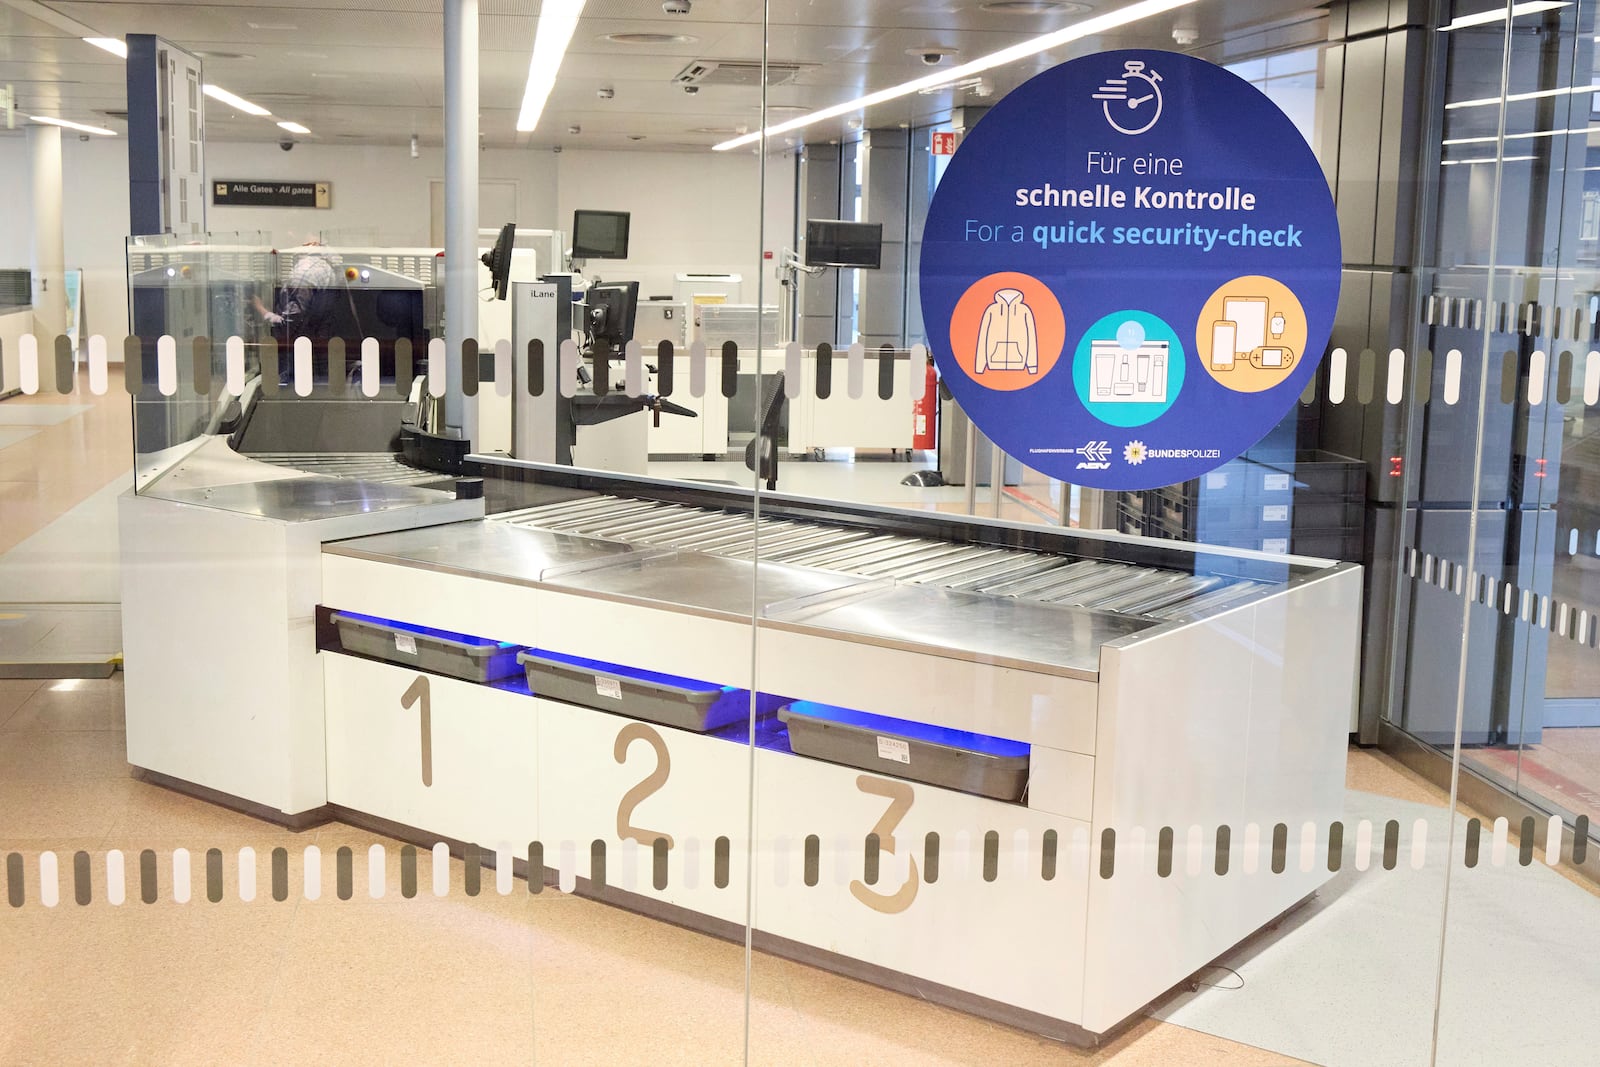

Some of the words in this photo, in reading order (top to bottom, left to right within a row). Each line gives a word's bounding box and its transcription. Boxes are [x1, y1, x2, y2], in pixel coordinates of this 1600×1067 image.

[1087, 151, 1127, 174] Für
[1133, 153, 1184, 176] eine
[233, 184, 249, 193] Alle
[250, 185, 273, 194] Gates
[279, 185, 291, 194] All
[291, 186, 313, 196] gates
[1015, 184, 1127, 209] schnelle
[1134, 187, 1256, 211] Kontrolle
[965, 220, 1003, 242] For
[1010, 226, 1025, 243] a
[1032, 221, 1106, 250] quick
[1112, 223, 1303, 252] security-check
[530, 289, 555, 298] iLane
[1148, 449, 1221, 459] BUNDESPOLIZEI
[400, 675, 432, 788] 1
[614, 723, 674, 849] 2
[849, 775, 919, 914] 3
